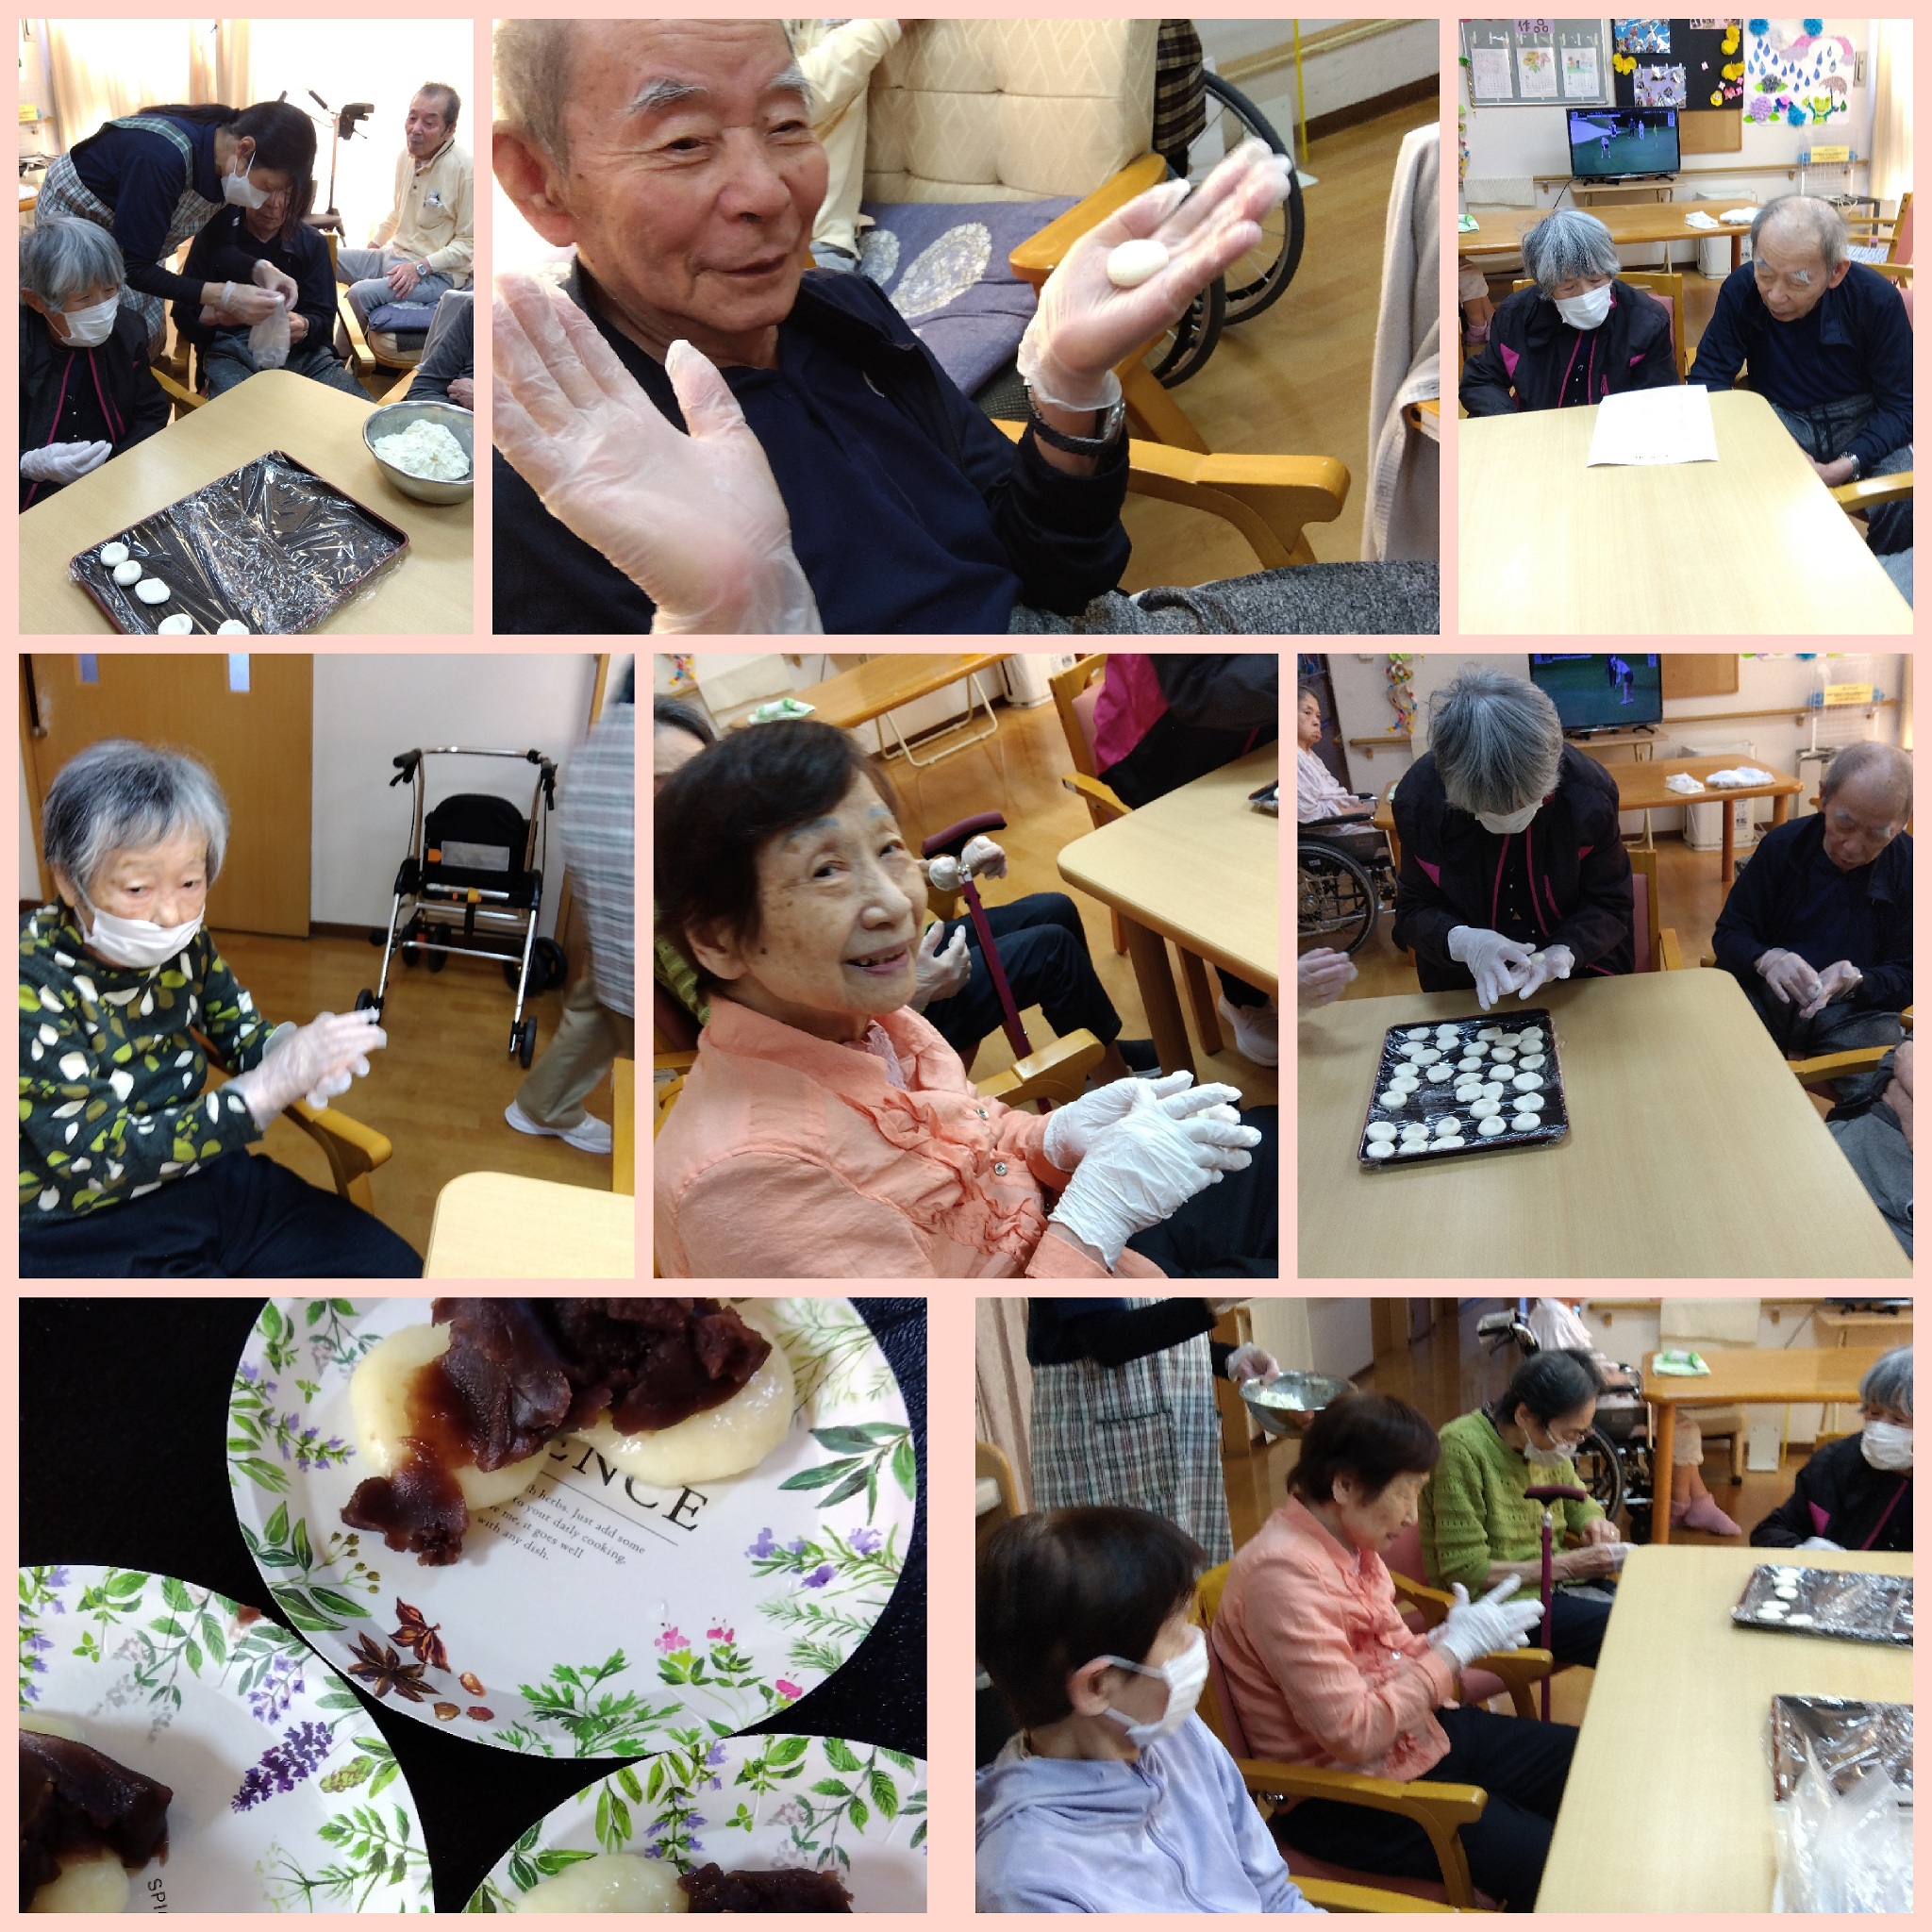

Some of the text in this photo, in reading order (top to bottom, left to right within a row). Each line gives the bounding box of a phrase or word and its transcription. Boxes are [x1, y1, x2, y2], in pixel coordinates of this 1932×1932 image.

[1518, 19, 1549, 33] 作品
[477, 1516, 549, 1561] with any dish.
[502, 1510, 521, 1525] me,
[523, 1522, 533, 1531] it
[531, 1528, 558, 1545] goes
[560, 1542, 584, 1559] well
[525, 1505, 551, 1522] your
[553, 1518, 580, 1539] daily
[581, 1535, 626, 1564] cooking.
[538, 1490, 569, 1513] herbs.
[571, 1508, 593, 1525] Just
[595, 1524, 618, 1539] add
[618, 1536, 645, 1554] some
[147, 1878, 168, 1913] SPI
